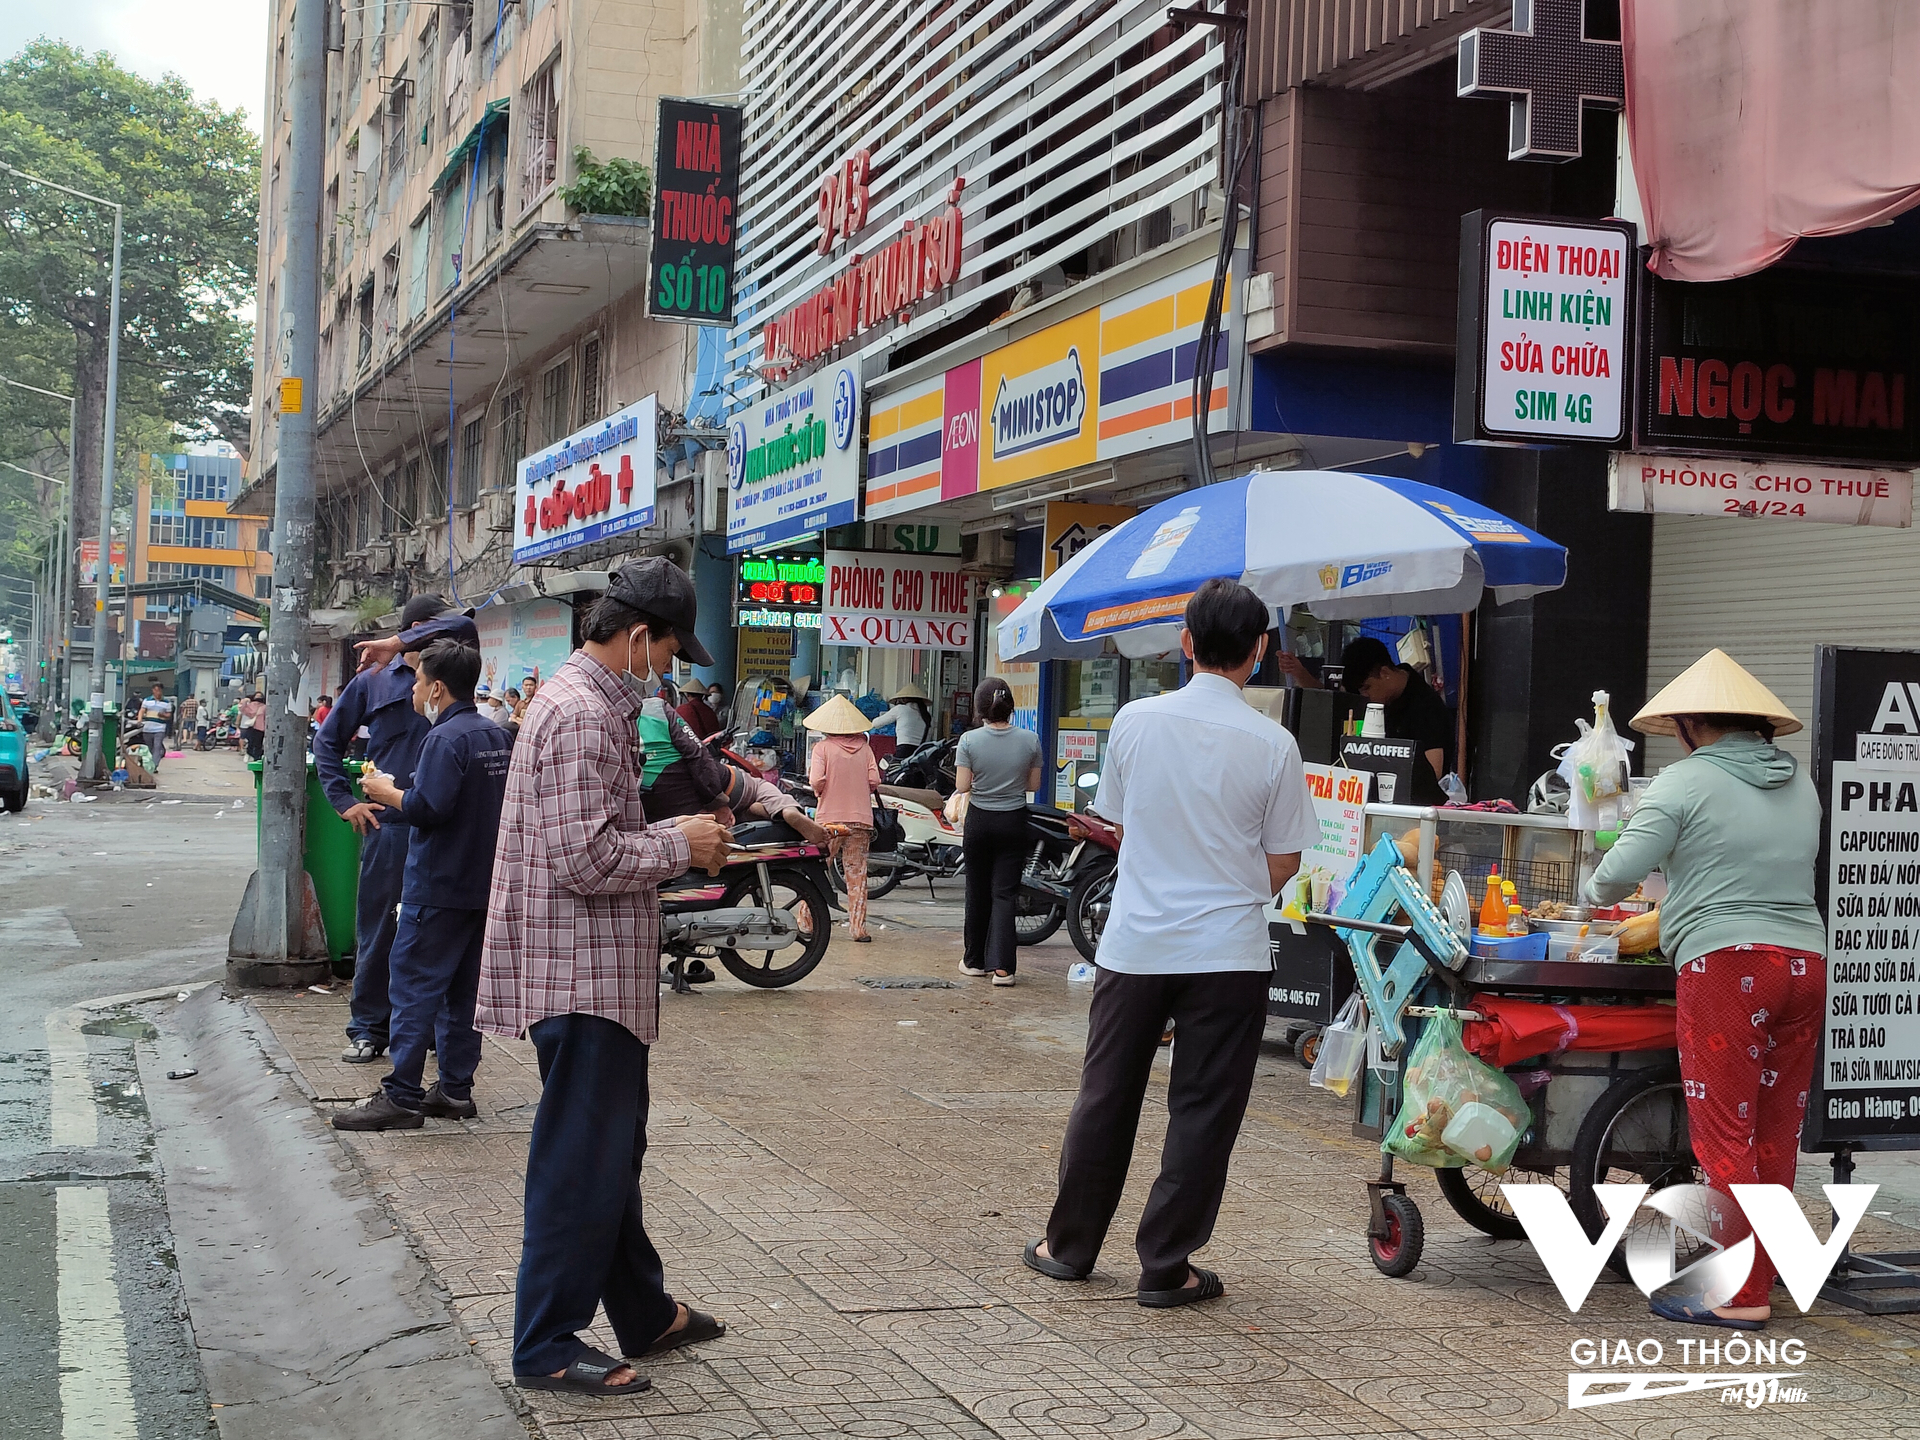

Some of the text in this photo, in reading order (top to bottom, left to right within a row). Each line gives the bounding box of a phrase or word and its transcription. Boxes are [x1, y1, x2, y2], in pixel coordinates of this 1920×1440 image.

[675, 113, 721, 173] NHÀ
[661, 177, 731, 246] THUỐC
[860, 220, 929, 328] THUẬT
[923, 177, 966, 293] SỐ
[1497, 235, 1619, 285] ĐIỆN THOẠI
[658, 249, 726, 314] SỐ 10
[1503, 288, 1611, 331] LINH KIỆN
[1500, 332, 1610, 378] SỬA CHỮA
[1515, 389, 1591, 423] SIM 4G
[1658, 356, 1904, 434] NGỌC MAI
[999, 378, 1078, 443] MINISTOP
[745, 413, 826, 483] NHÀ THUỐC SỐ 10
[1641, 464, 1890, 498] PHÒNG CHO THUÊ
[540, 480, 574, 531] CẤP
[573, 463, 612, 520] CỨU
[1724, 499, 1806, 517] 24/24
[743, 558, 826, 583] NHÀ THUỐC
[830, 558, 884, 610] PHÒNG
[892, 568, 924, 611] CHO
[750, 581, 815, 602] SỐ 10
[739, 607, 823, 629] PHÒNG CHO
[1343, 742, 1410, 758] AVA COFFEE
[1861, 741, 1881, 759] CAFE
[1882, 738, 1903, 760] ĐÔNG
[1305, 771, 1363, 805] TRÀ SỮA
[1841, 781, 1918, 812] PHA
[1343, 809, 1355, 819] SIZE
[1840, 831, 1919, 852] CAPUCHINO
[1838, 864, 1866, 884] ĐEN
[1836, 893, 1863, 917] SỮA
[1866, 922, 1888, 950] XỈU
[1892, 925, 1909, 950] ĐÁ
[1833, 957, 1915, 984] CACAO SỮA ĐÁ
[1268, 987, 1320, 1007] 0905 405 677
[1832, 990, 1912, 1016] SỮA TƯƠI CÀ
[1831, 1023, 1886, 1049] TRÀ ĐÀO
[1830, 1056, 1848, 1082] TRÀ
[1851, 1056, 1871, 1082] SỮA
[1828, 1098, 1860, 1119] Giao
[1864, 1095, 1906, 1120] Hàng:
